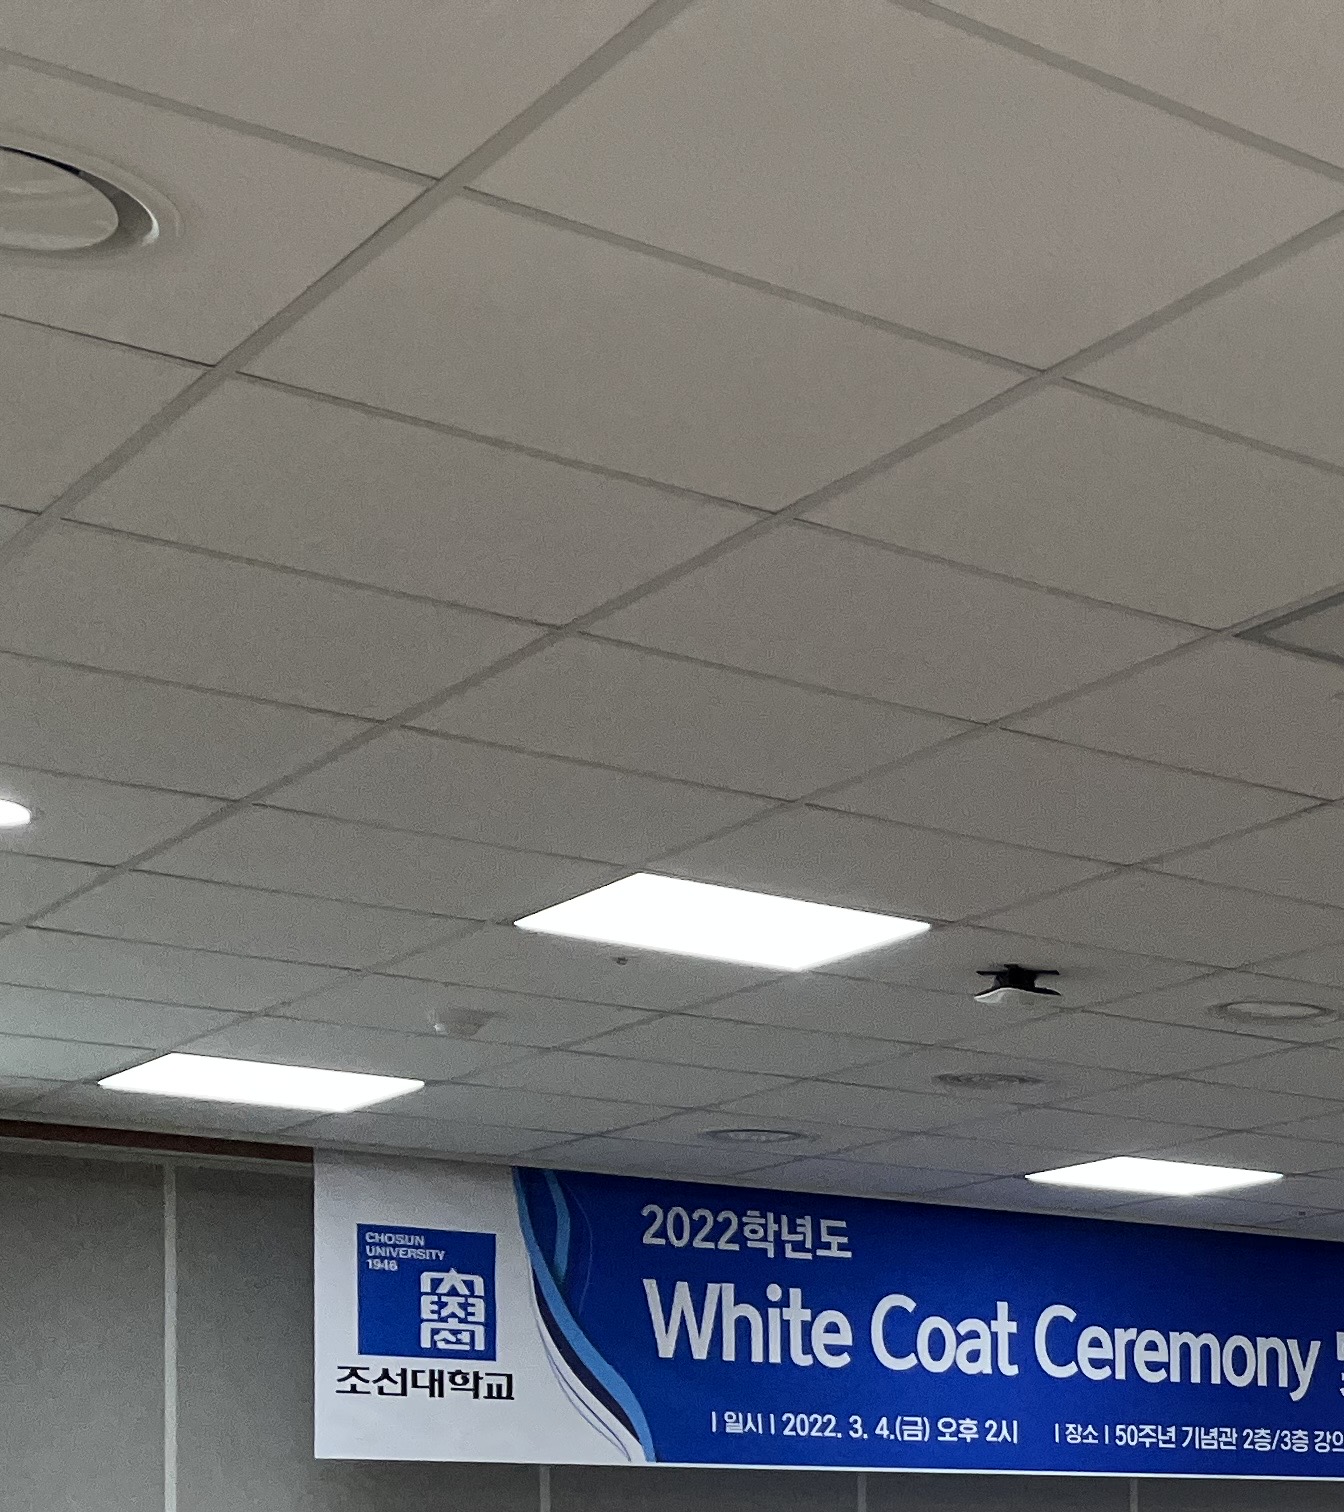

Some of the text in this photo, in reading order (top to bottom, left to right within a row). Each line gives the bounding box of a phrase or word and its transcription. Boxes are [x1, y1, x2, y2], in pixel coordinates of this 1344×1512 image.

[365, 1231, 425, 1246] CHOSUN
[643, 1206, 851, 1259] 2022학년도
[365, 1245, 446, 1261] UNIVERSITY
[366, 1258, 398, 1271] 1946
[643, 1279, 852, 1367] White
[871, 1294, 1018, 1376] Coat
[1035, 1305, 1320, 1401] Ceremony
[336, 1366, 514, 1400] 조선대학교
[782, 1413, 841, 1438] 2022.
[849, 1416, 868, 1438] 3.
[938, 1418, 978, 1442] 오후
[985, 1420, 1017, 1443] 2시
[1116, 1425, 1175, 1448] 50주년
[1182, 1427, 1237, 1449] 기념관
[1243, 1428, 1308, 1452] 2층/3층
